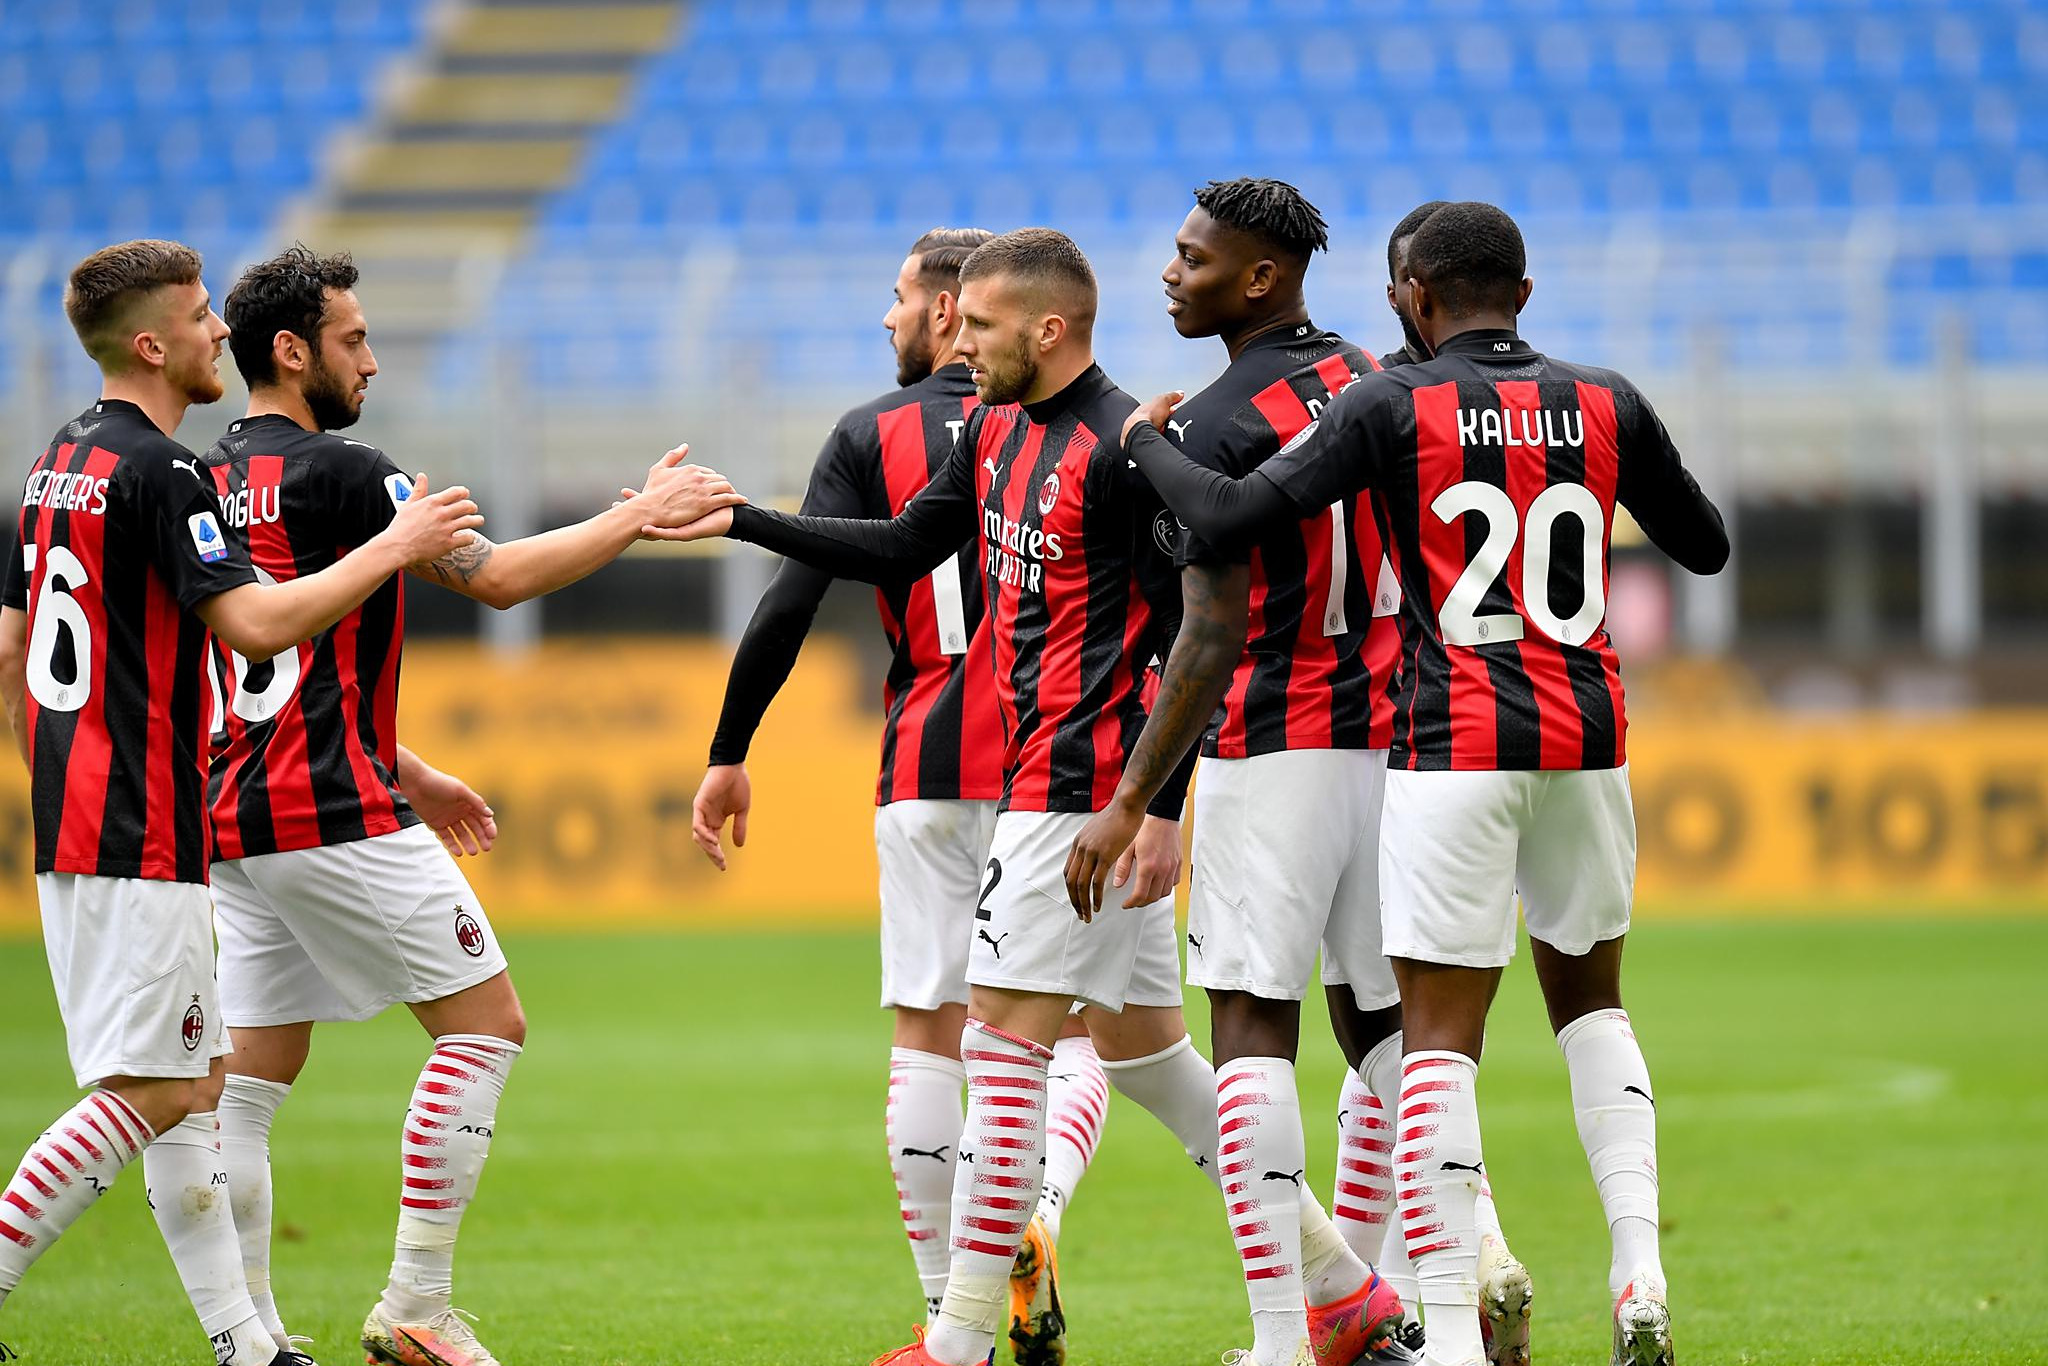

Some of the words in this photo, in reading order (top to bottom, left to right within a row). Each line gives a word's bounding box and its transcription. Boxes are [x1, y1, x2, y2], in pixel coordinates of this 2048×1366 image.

[1492, 342, 1511, 352] ACM
[1456, 408, 1584, 447] KALULU
[1430, 481, 1606, 648] 20
